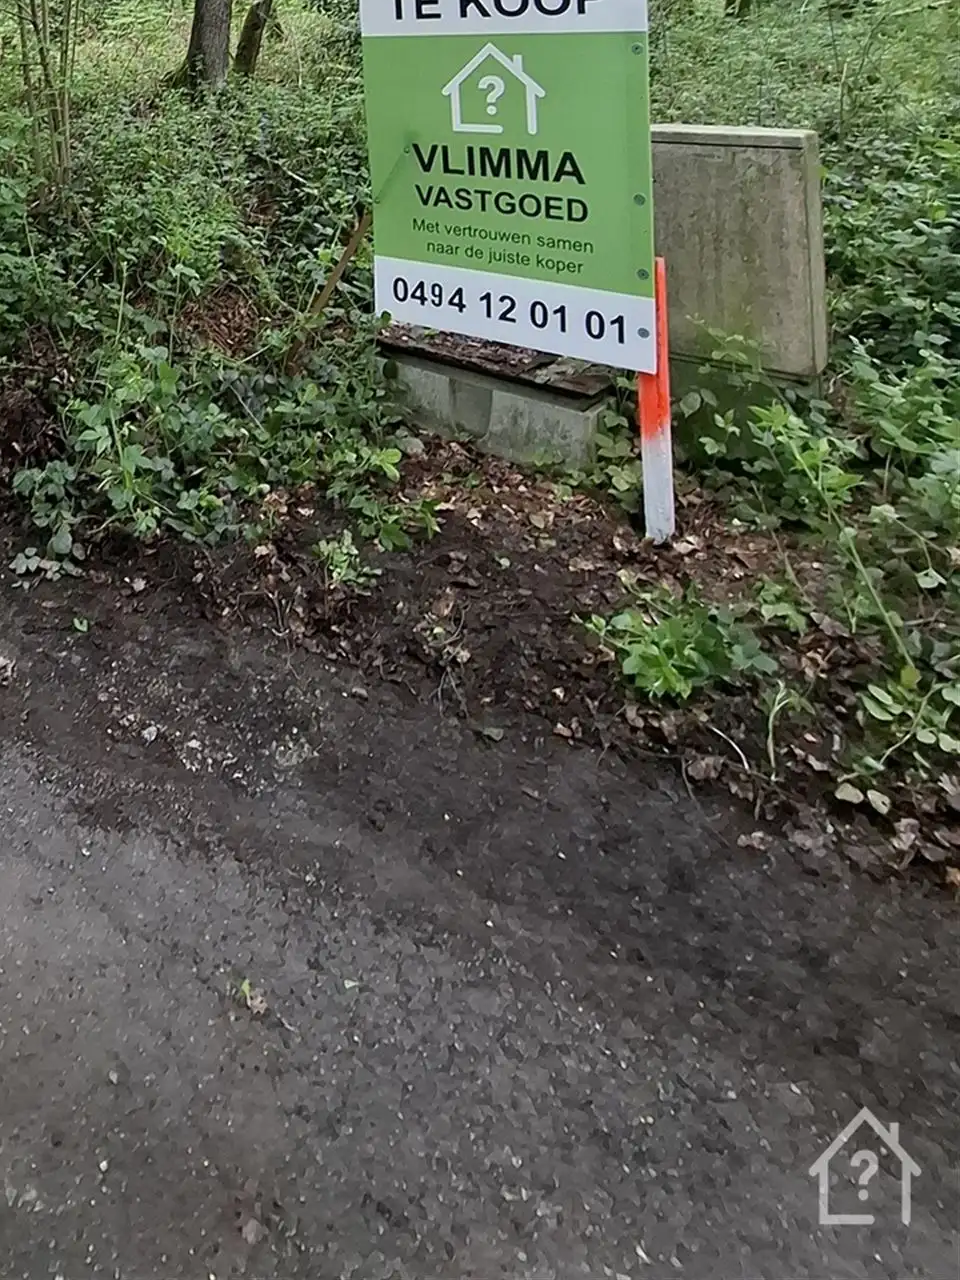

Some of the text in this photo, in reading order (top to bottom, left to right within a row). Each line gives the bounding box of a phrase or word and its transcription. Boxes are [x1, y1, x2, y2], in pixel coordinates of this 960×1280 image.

[412, 143, 586, 185] VLIMMA
[415, 184, 589, 223] VASTGOED
[412, 218, 594, 254] Met vertrouwen samen
[426, 240, 584, 274] naar de juiste koper
[392, 277, 625, 344] 0494 12 01 01
